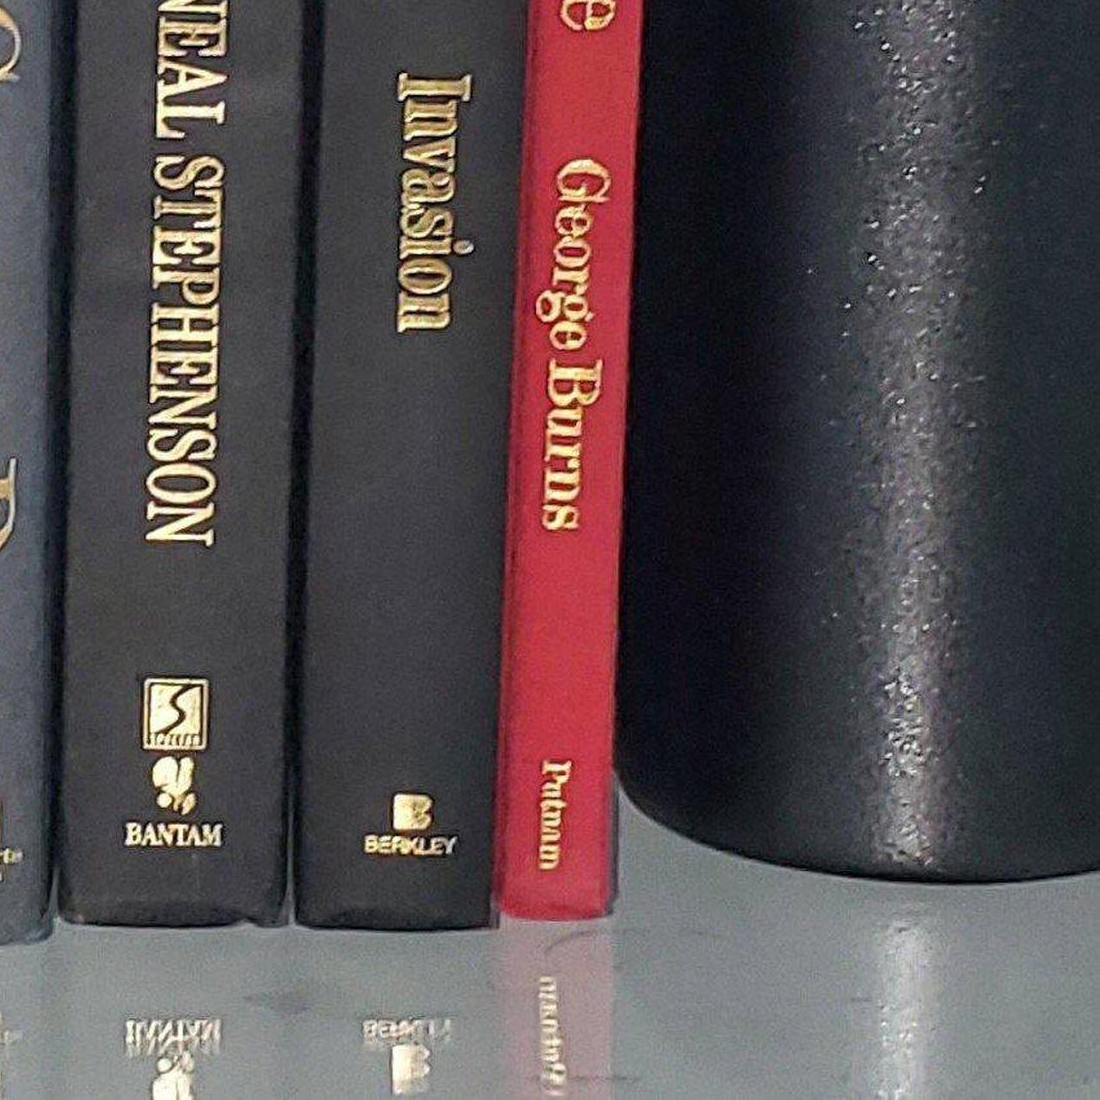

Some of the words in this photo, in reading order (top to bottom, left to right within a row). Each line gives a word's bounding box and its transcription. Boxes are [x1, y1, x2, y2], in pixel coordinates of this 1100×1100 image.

[398, 73, 473, 332] Invasion
[536, 159, 611, 349] George
[146, 156, 224, 546] STEPHENSON
[543, 358, 602, 530] Burns
[125, 822, 222, 846] BANTAM
[365, 835, 457, 855] BERKLEY
[539, 760, 571, 869] Putnam
